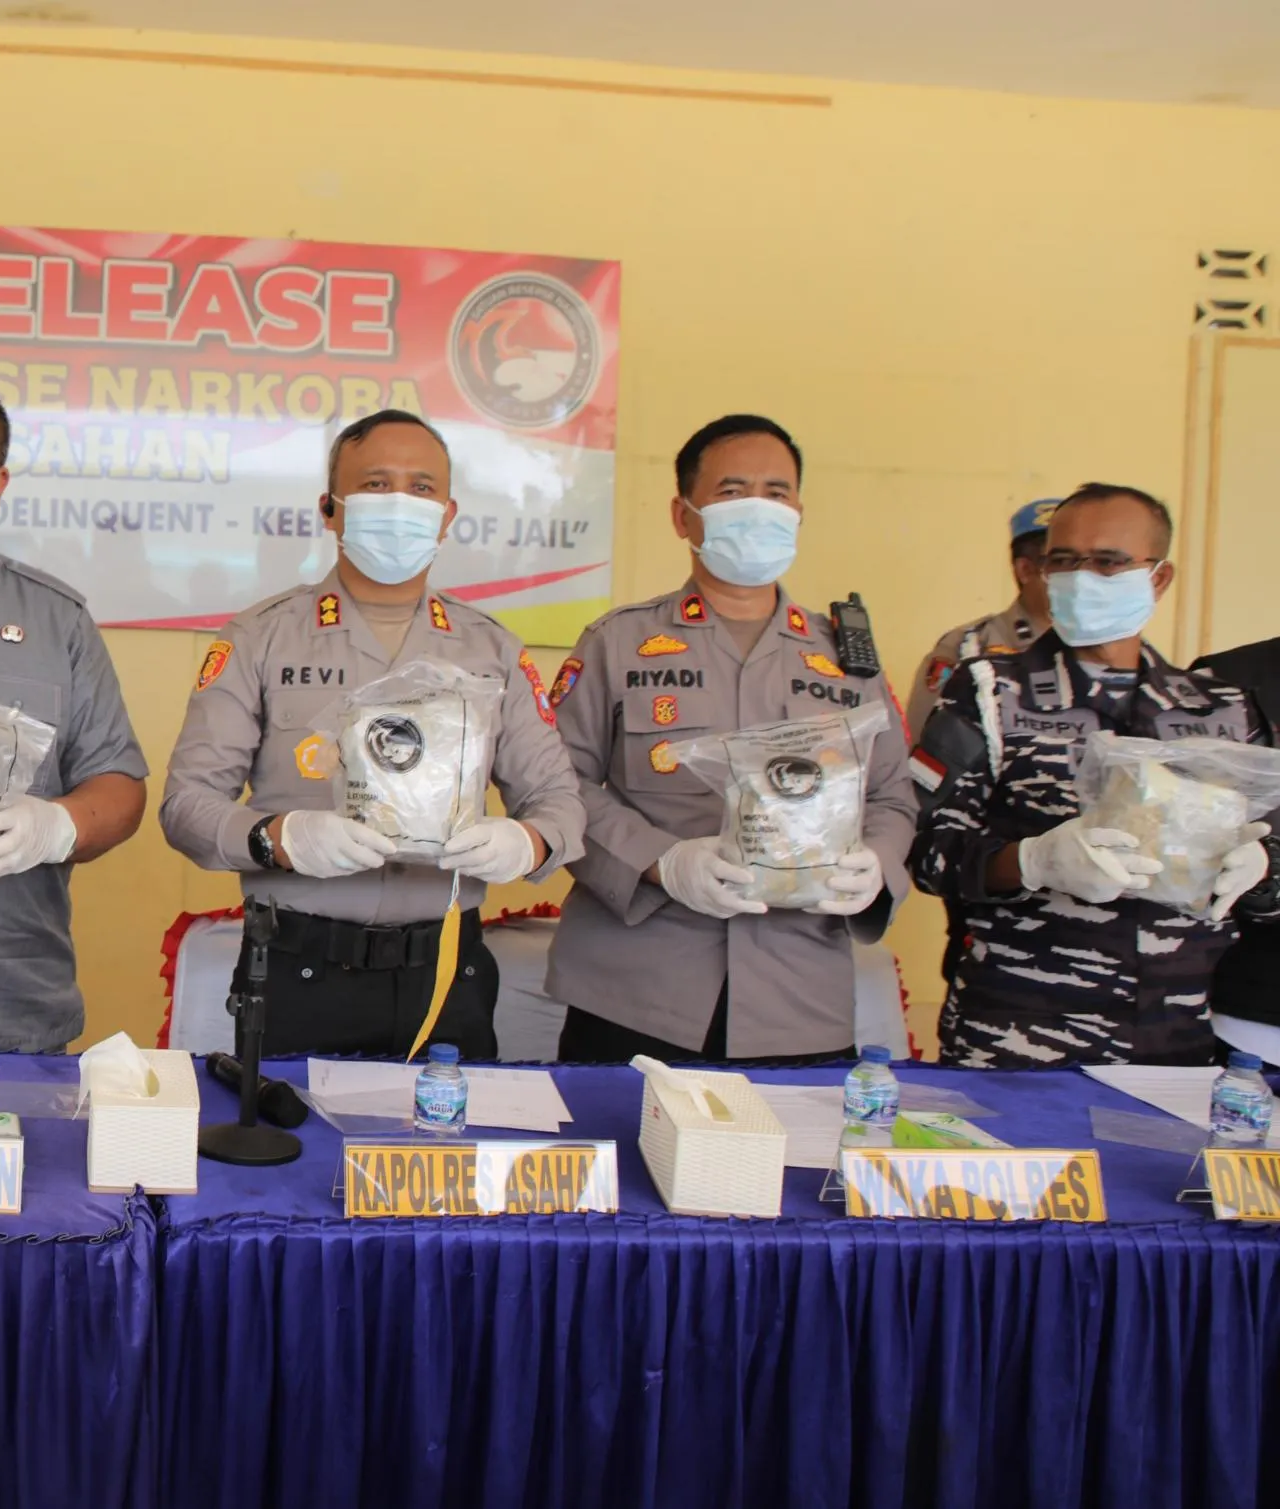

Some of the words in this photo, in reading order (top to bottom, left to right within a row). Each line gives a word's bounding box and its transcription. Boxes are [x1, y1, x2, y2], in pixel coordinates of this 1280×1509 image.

[90, 366, 428, 424] NARKOBA
[7, 422, 232, 482] SAHAN
[454, 514, 498, 546] OF
[281, 666, 344, 685] REVI
[626, 669, 704, 689] RIYADI
[791, 679, 861, 708] POLRI
[1014, 713, 1087, 735] HEPPY
[1168, 723, 1209, 737] TNI
[427, 1102, 453, 1113] AQUA
[352, 1152, 494, 1213] KAPOLRES
[505, 1153, 615, 1213] ASAHAN
[853, 1158, 957, 1218] WAKA
[961, 1159, 1091, 1219] POLRES
